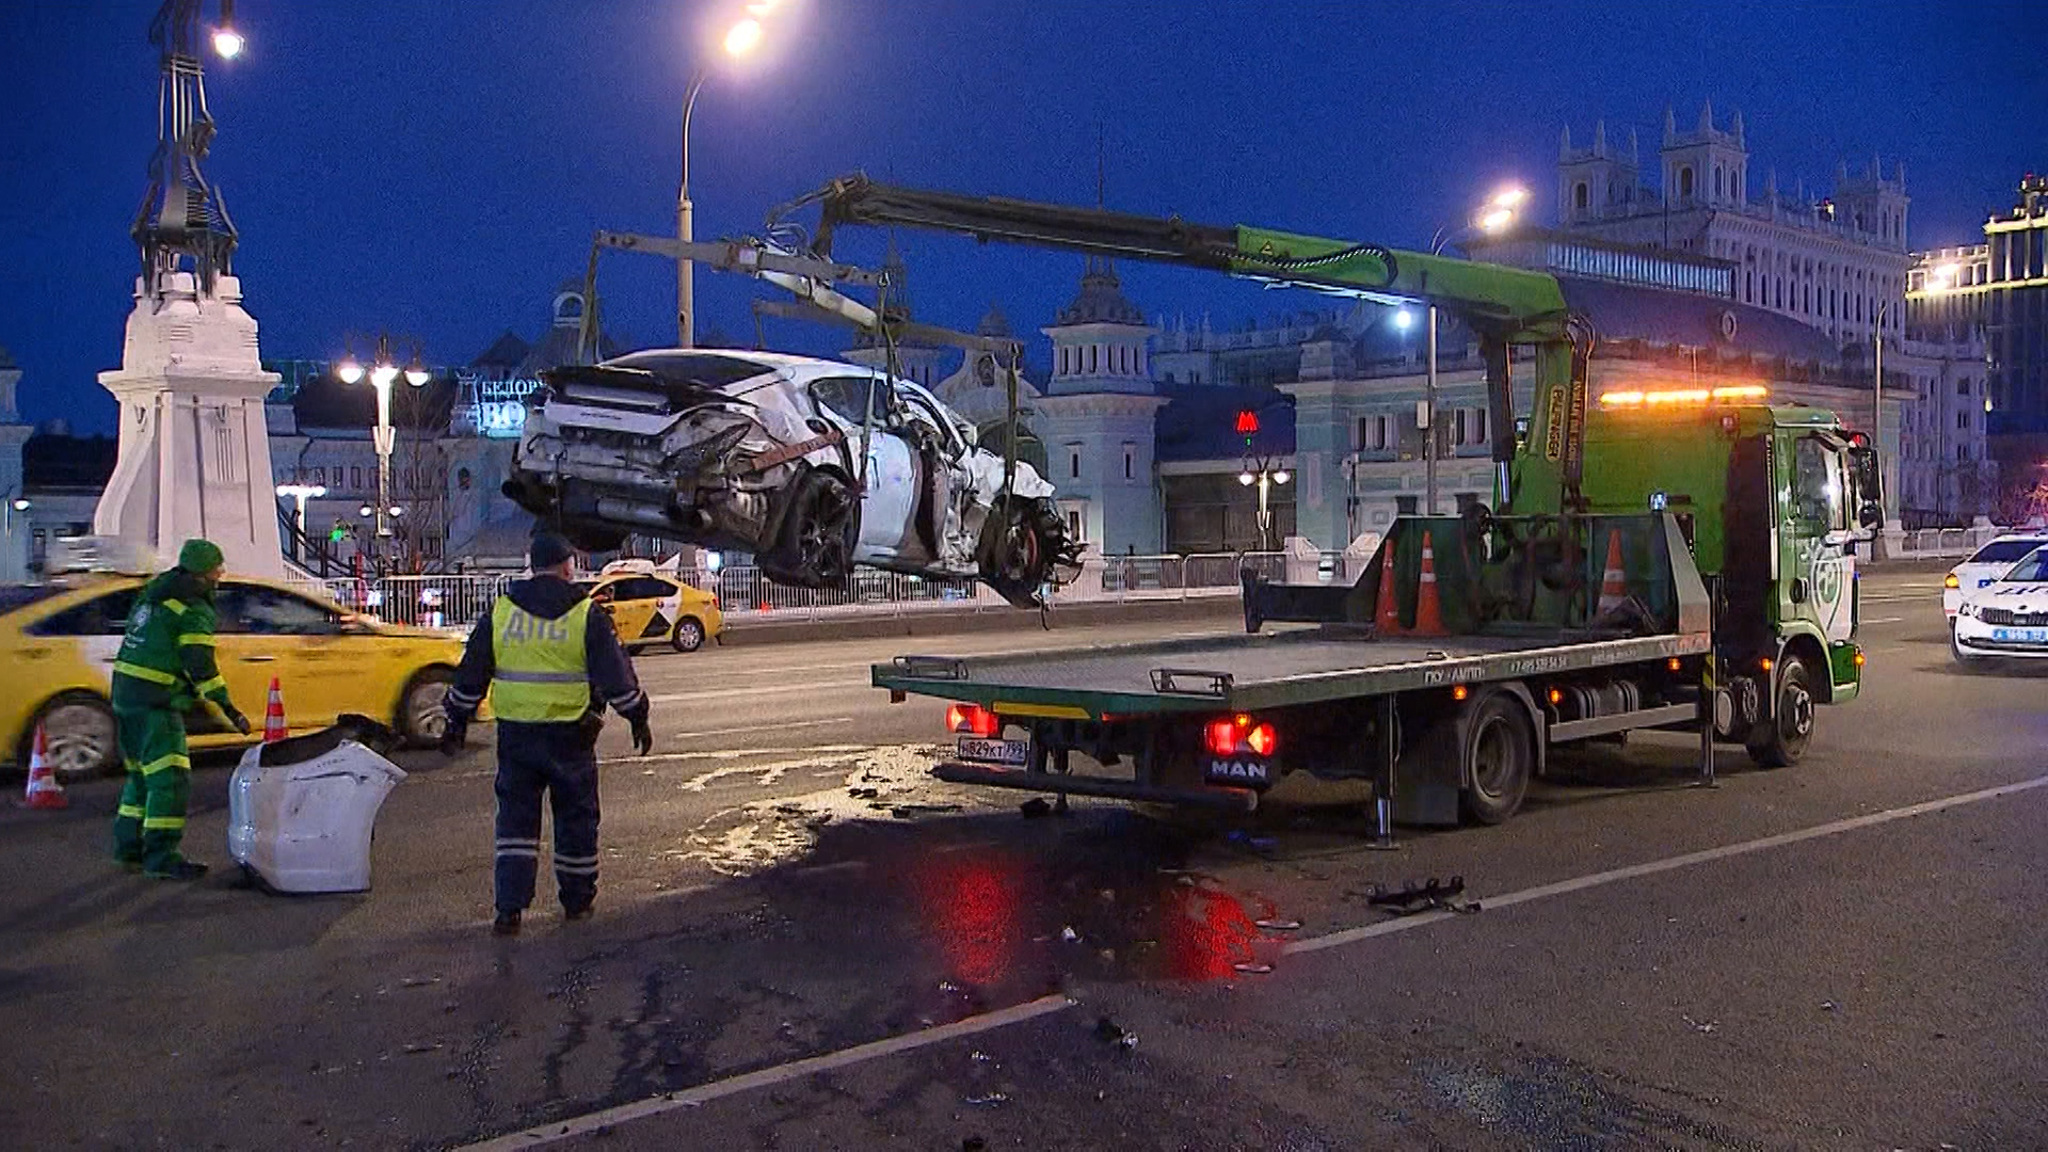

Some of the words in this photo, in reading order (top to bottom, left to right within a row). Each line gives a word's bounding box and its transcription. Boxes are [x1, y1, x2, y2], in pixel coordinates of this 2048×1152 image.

[1236, 411, 1258, 431] М
[503, 608, 569, 647] ДПС
[1211, 760, 1267, 778] MAN
